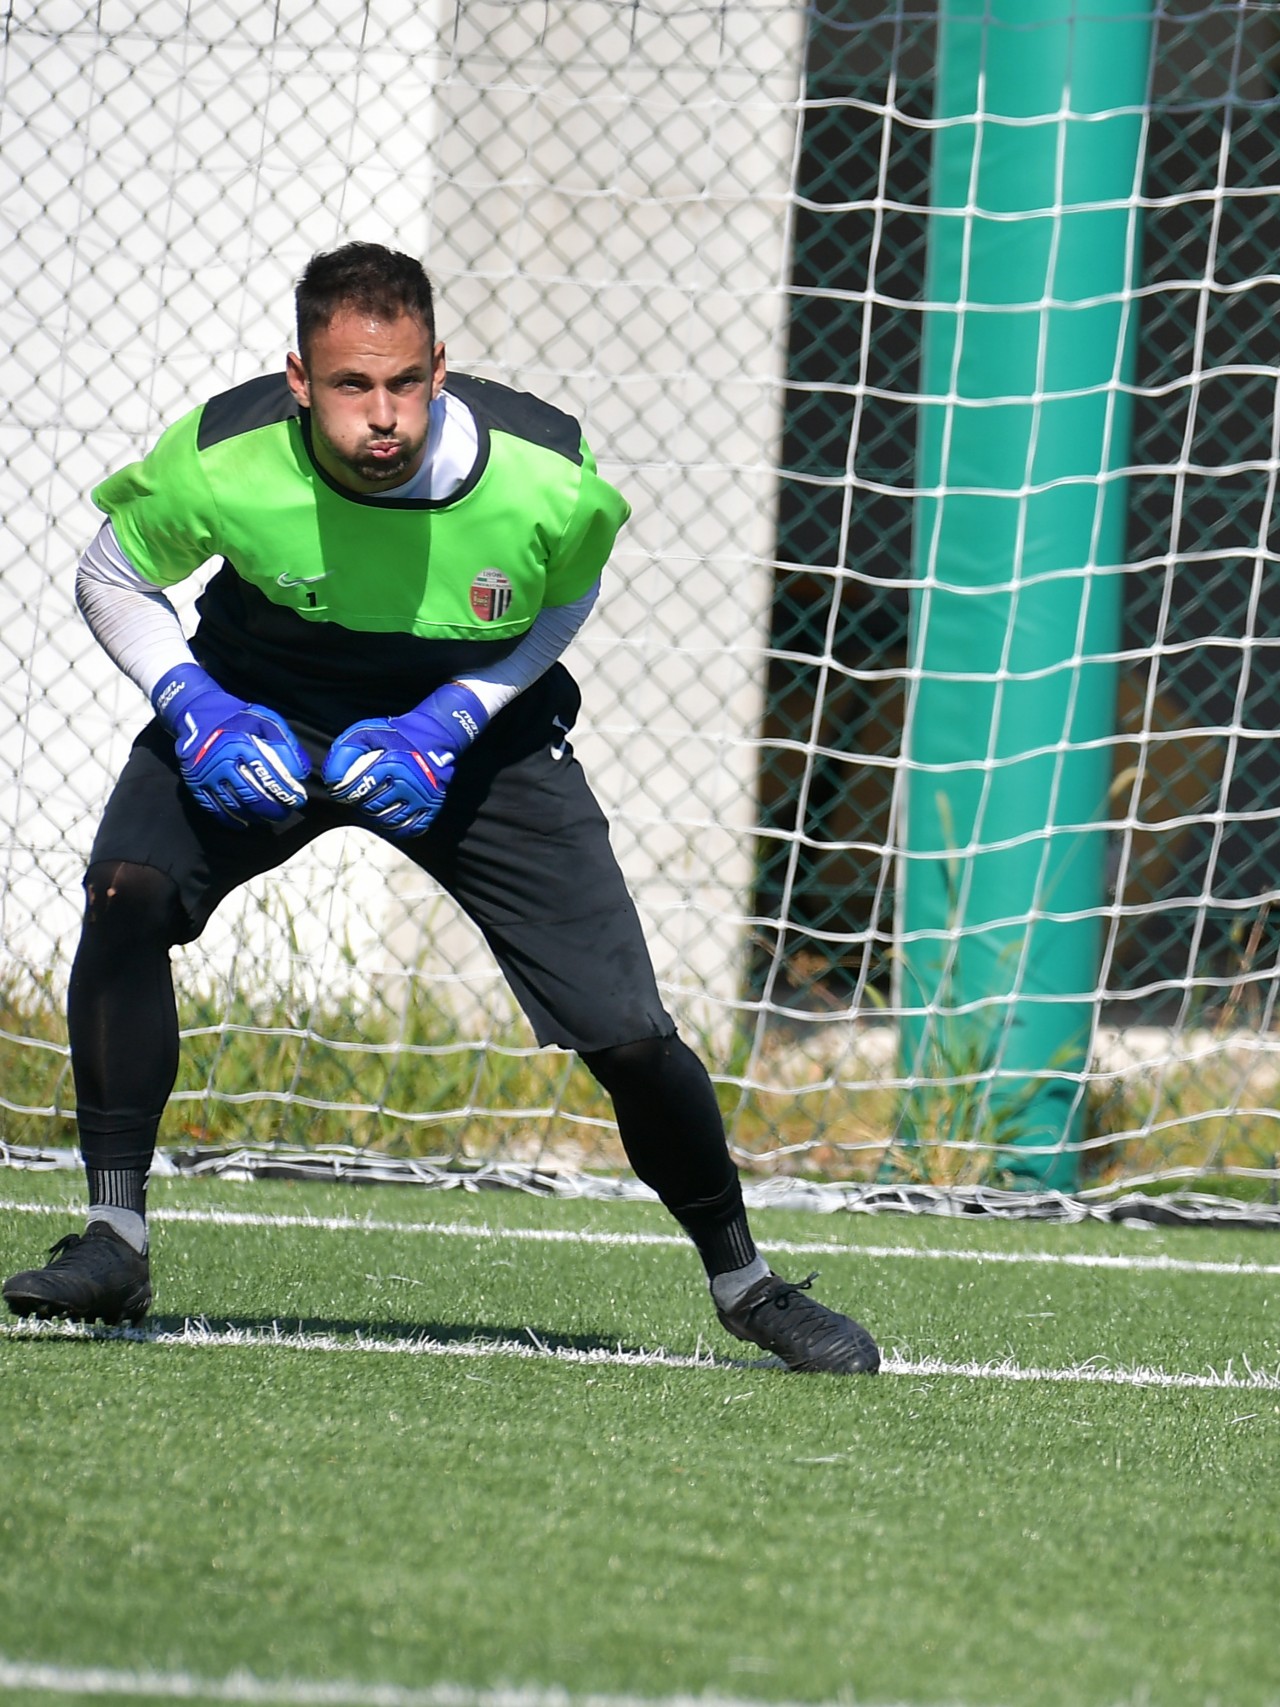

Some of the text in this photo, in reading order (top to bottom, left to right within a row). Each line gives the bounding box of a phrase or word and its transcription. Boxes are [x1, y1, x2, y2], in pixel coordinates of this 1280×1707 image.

[305, 591, 317, 607] 1
[249, 759, 298, 806] reusch
[346, 775, 377, 801] sch
